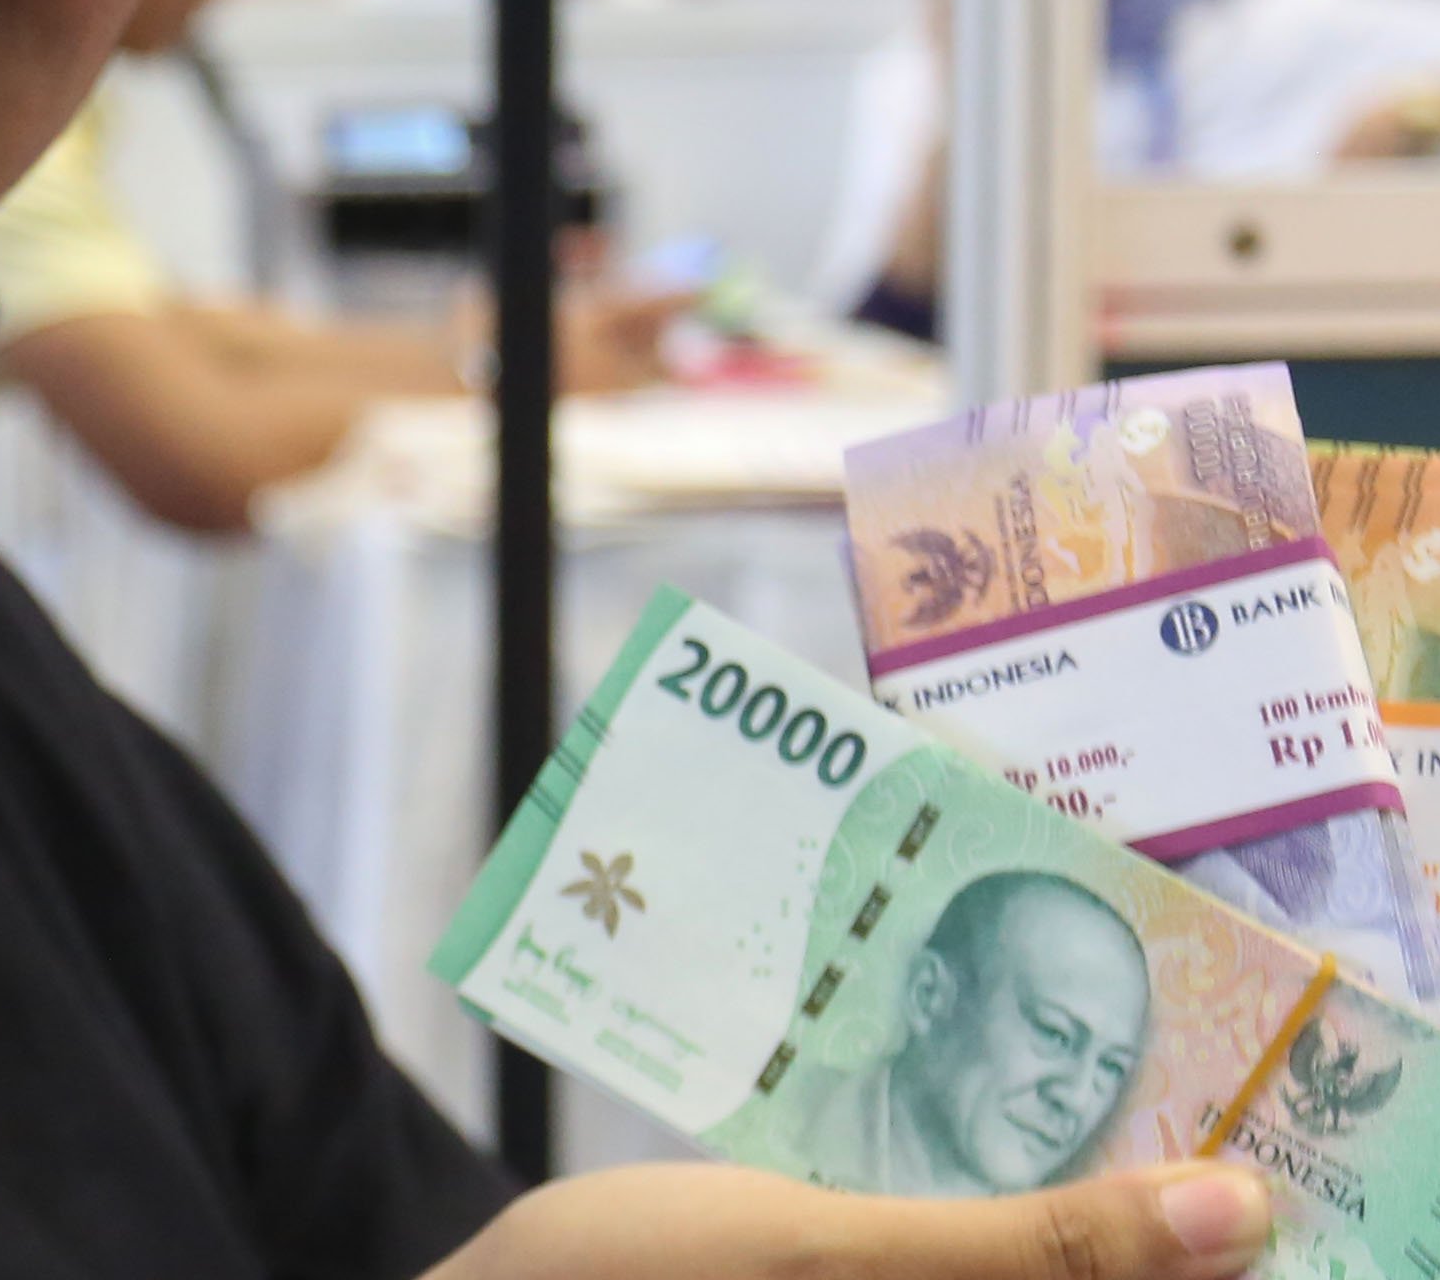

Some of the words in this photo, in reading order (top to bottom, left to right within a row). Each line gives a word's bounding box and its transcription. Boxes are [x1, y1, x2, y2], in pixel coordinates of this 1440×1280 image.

[1232, 582, 1323, 627] BANK
[912, 648, 1079, 711] INDONESIA
[656, 637, 867, 788] 20000
[1260, 696, 1299, 728] 100
[1268, 734, 1325, 769] Rp
[1199, 1102, 1366, 1223] IDONESIA
